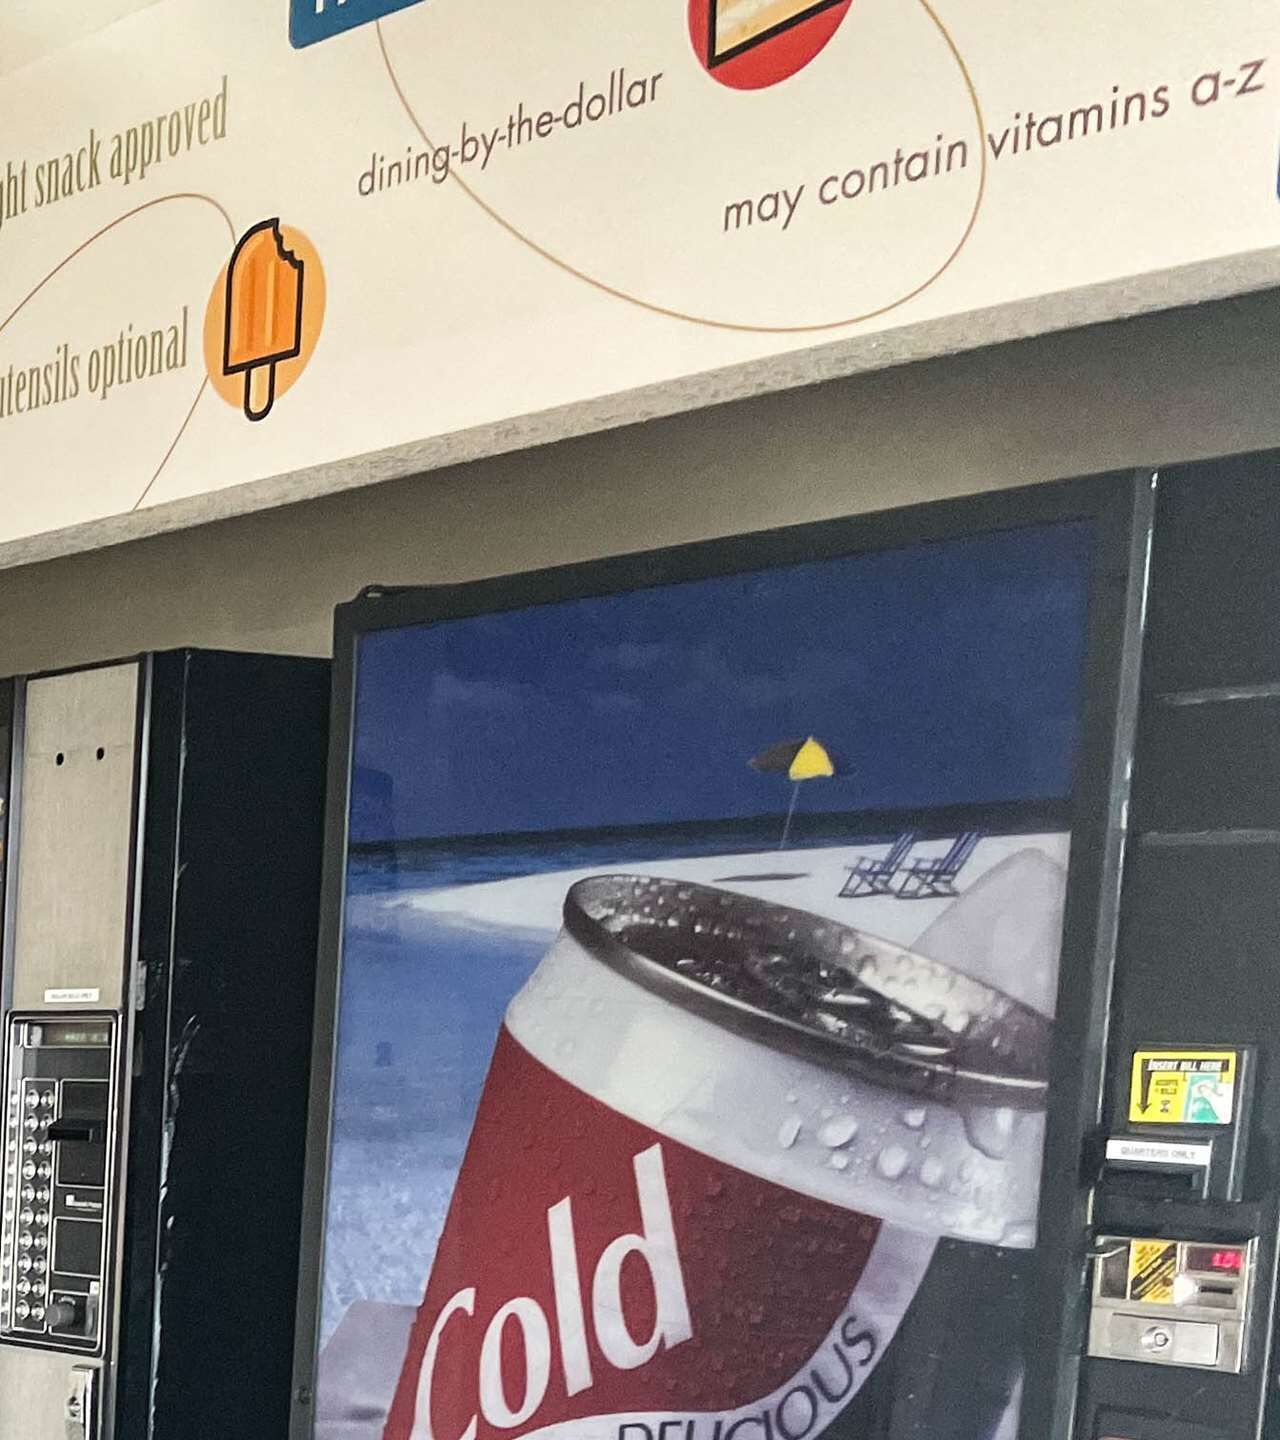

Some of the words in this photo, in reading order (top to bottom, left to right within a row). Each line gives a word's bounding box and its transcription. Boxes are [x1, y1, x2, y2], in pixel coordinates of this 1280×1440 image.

[34, 128, 101, 209] snack
[109, 75, 228, 190] approved
[358, 71, 663, 197] dining-by-the-dollar
[723, 187, 804, 233] may
[818, 136, 968, 206] contain
[987, 83, 1169, 162] vitamins
[1190, 58, 1266, 109] a-z
[87, 306, 189, 400] optional
